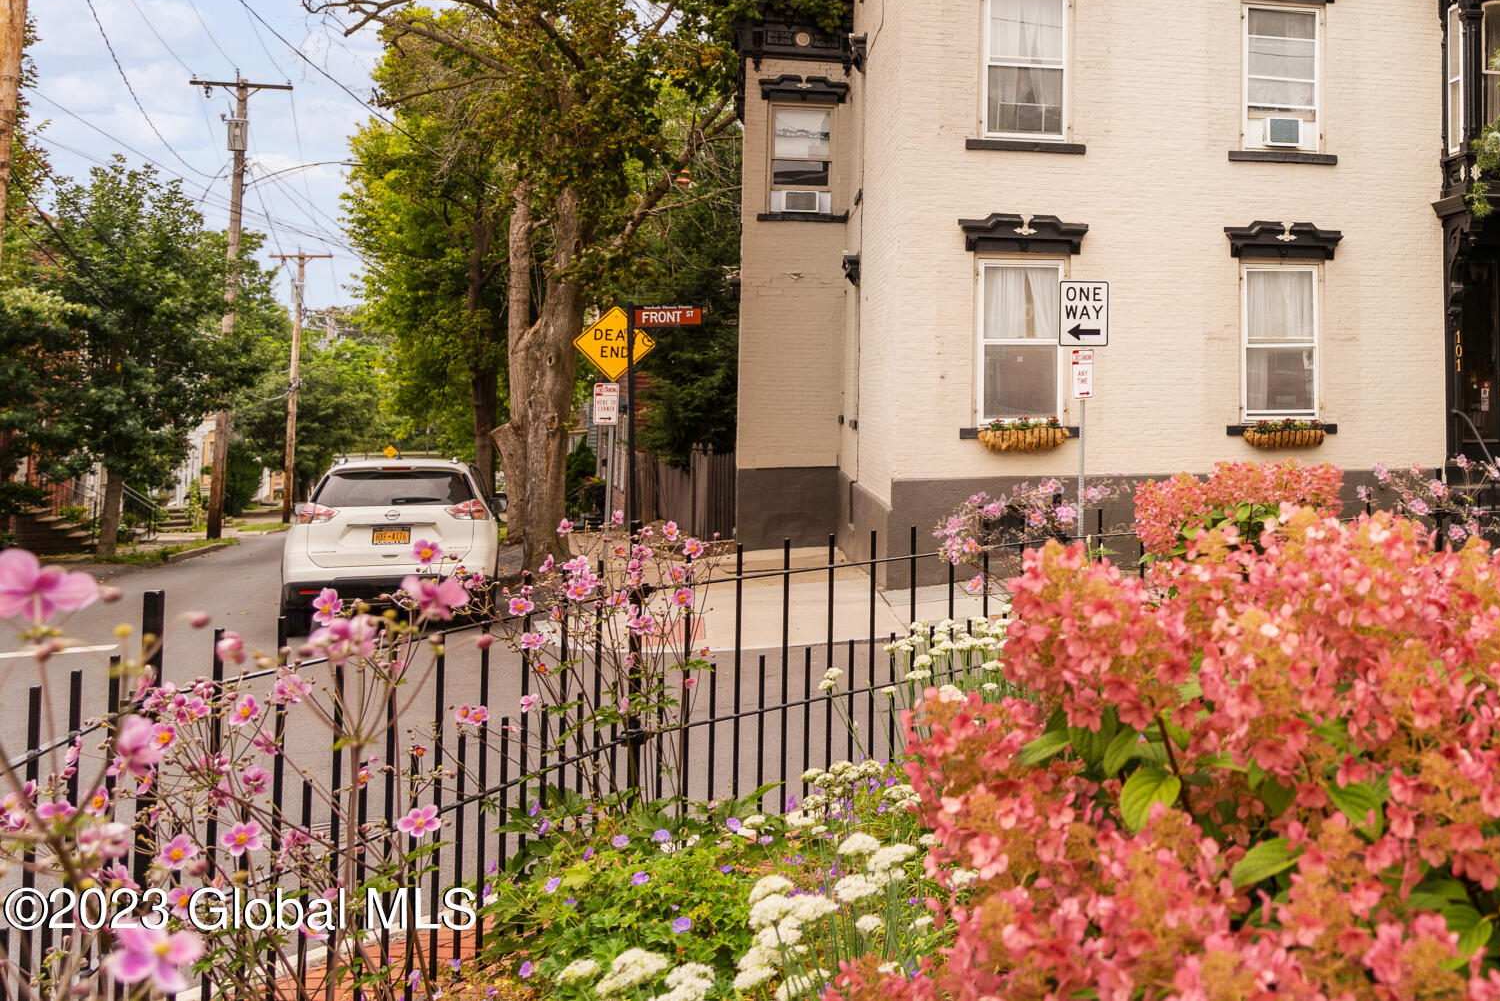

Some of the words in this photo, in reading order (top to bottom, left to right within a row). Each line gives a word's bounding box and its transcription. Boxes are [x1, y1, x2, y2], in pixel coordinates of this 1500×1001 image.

[1066, 286, 1102, 301] ONE
[641, 311, 682, 323] FRONT
[1065, 305, 1103, 319] WAY
[594, 328, 637, 341] DEA
[600, 346, 630, 358] END
[1455, 330, 1463, 372] 101
